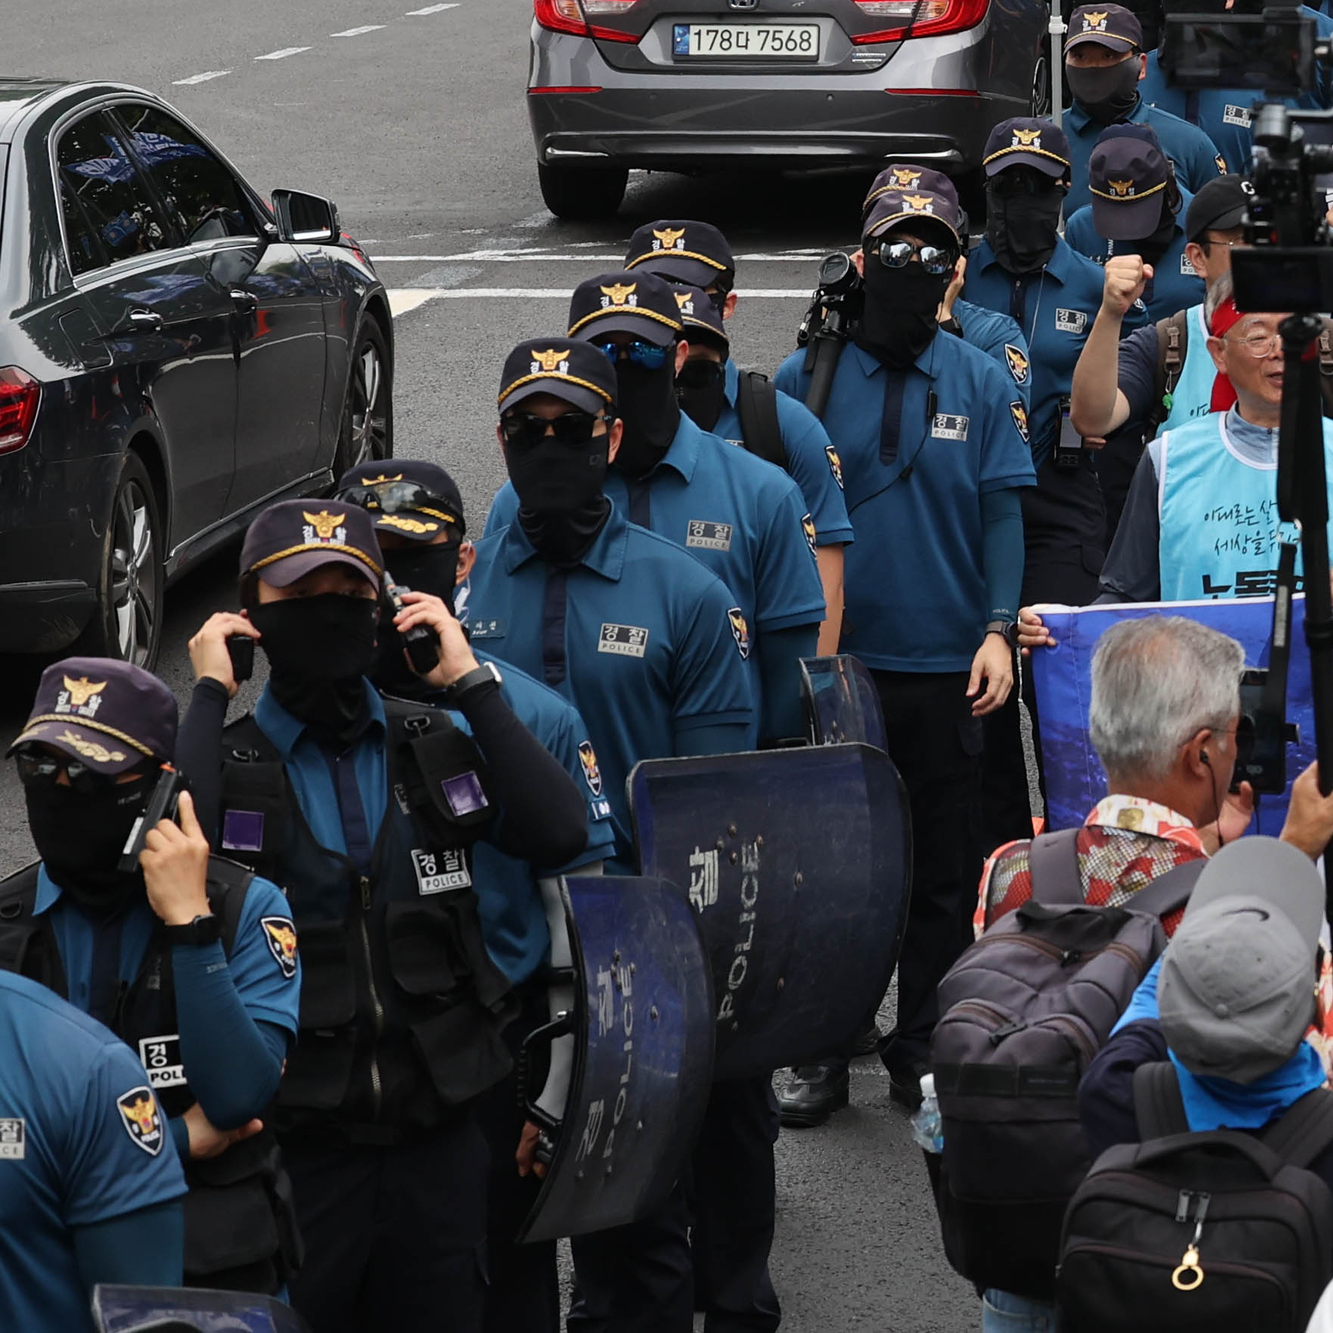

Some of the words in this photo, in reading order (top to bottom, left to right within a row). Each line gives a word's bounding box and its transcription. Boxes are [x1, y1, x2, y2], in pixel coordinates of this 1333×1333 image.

[693, 28, 751, 53] 178다
[758, 28, 813, 53] 7568
[932, 429, 966, 441] POLICE
[600, 642, 644, 656] POLICE
[717, 841, 760, 1022] POLICE
